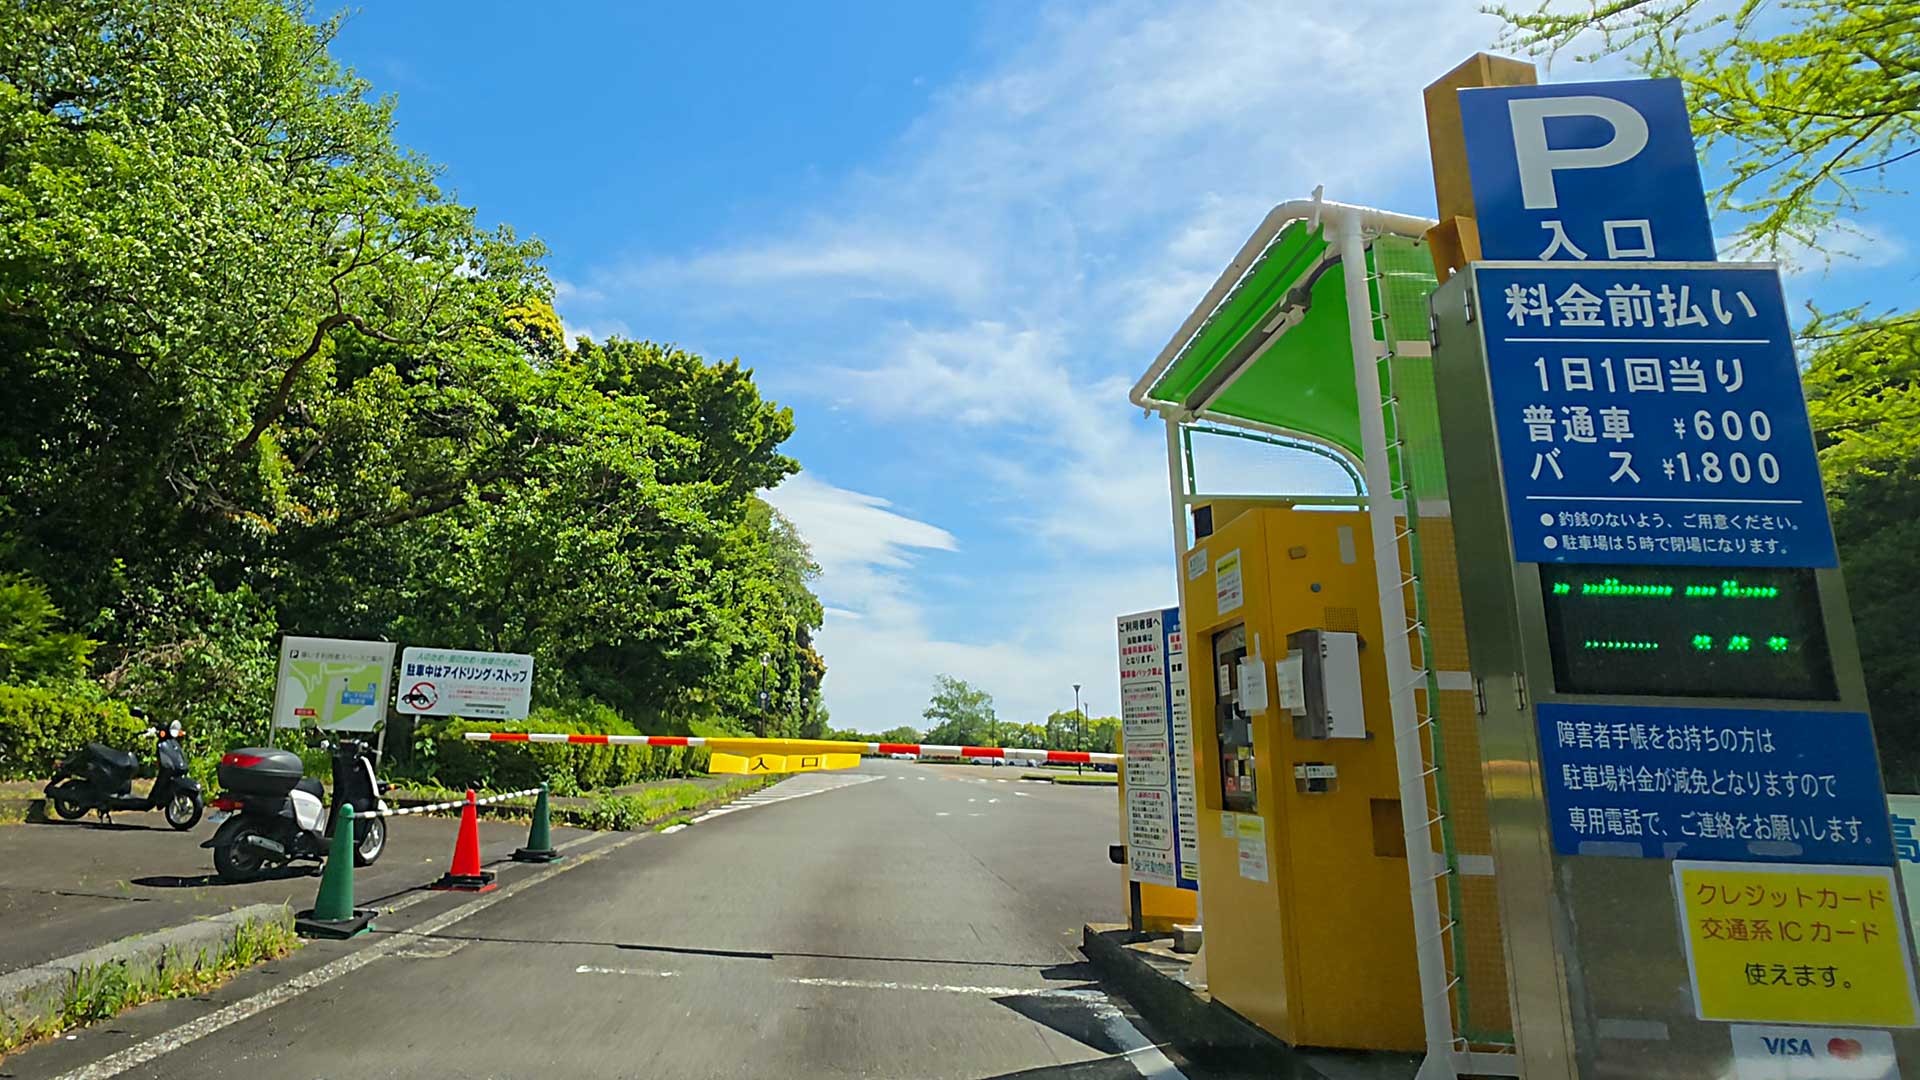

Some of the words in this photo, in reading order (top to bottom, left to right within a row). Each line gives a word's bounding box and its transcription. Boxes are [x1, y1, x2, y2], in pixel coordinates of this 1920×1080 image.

[1508, 96, 1649, 209] P
[1538, 219, 1655, 261] 入口
[1504, 283, 1757, 328] 料金前払い
[1534, 356, 1744, 393] 1日1回当り
[1523, 404, 1634, 443] 普通車
[1673, 410, 1771, 441] ¥600
[1662, 451, 1780, 484] ¥1,800
[1558, 511, 1799, 531] 釣銭のないよう、ご用意ください。
[1562, 534, 1787, 555] 駐車場は5時で閉場になります。
[1119, 618, 1160, 633] ご利用者様へ
[406, 663, 528, 683] 駐車中はアイドリング・ストップ
[1557, 720, 1776, 753] 障害者手帳をお持ちの方は
[751, 757, 818, 771] 入口
[1562, 763, 1837, 798] 駐車場料金が減免となりますので
[1568, 806, 1872, 844] 専用電話で、ご連絡をお願いします。
[1697, 883, 1886, 910] クレジットカード
[1701, 918, 1879, 944] 交通系ICカード
[1744, 962, 1852, 989] 使えます。
[1760, 1036, 1814, 1057] VISA
